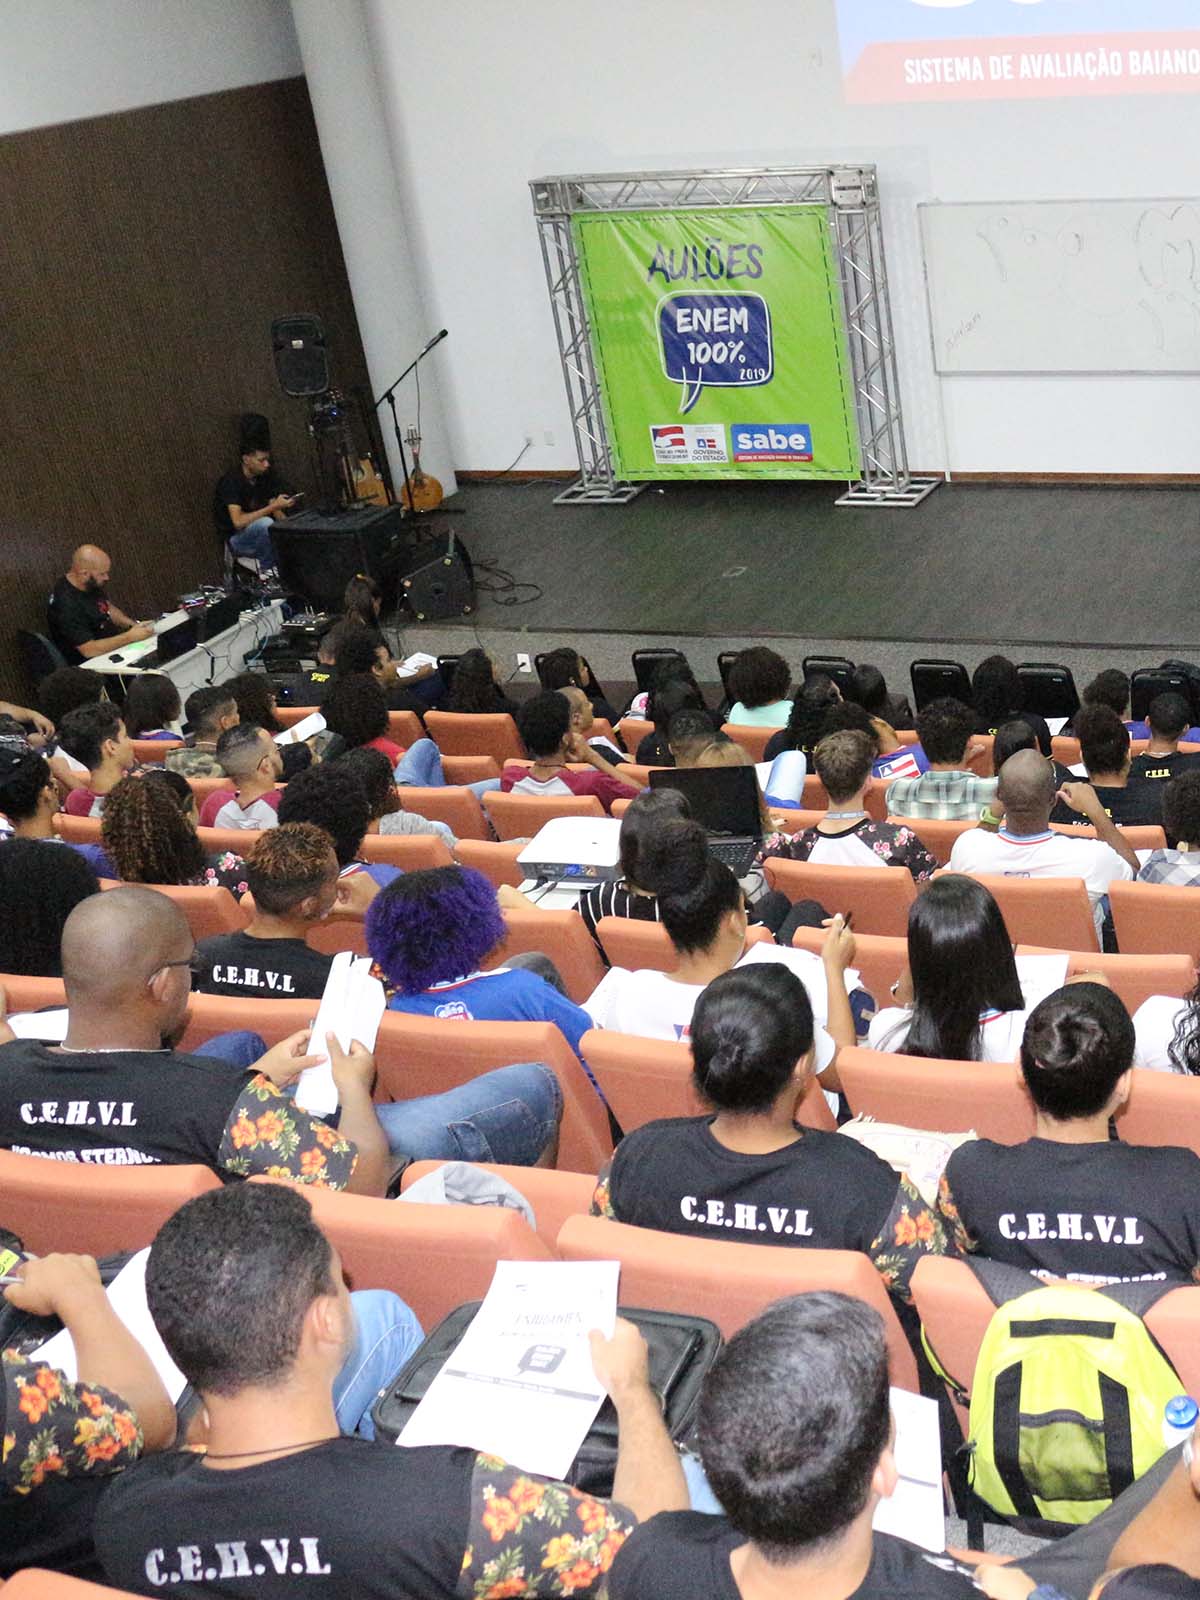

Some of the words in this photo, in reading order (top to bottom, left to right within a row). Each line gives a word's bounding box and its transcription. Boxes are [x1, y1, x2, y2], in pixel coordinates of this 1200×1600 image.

[904, 56, 984, 84] SISTEMA
[989, 55, 1014, 80] DE
[1019, 47, 1122, 80] AVALIAÇÃO
[1128, 48, 1200, 76] BAIANO
[648, 236, 763, 283] AULÕES
[676, 306, 749, 334] ENEM
[687, 340, 746, 365] 100%
[739, 368, 766, 380] 2019
[737, 429, 806, 450] sabe
[213, 964, 295, 993] C.E.H.V.L
[20, 1101, 138, 1126] C.E.H.V.L
[680, 1195, 814, 1237] C.E.H.V.L
[998, 1213, 1144, 1245] C.E.H.V.L
[145, 1537, 332, 1586] C.E.H.V.L
